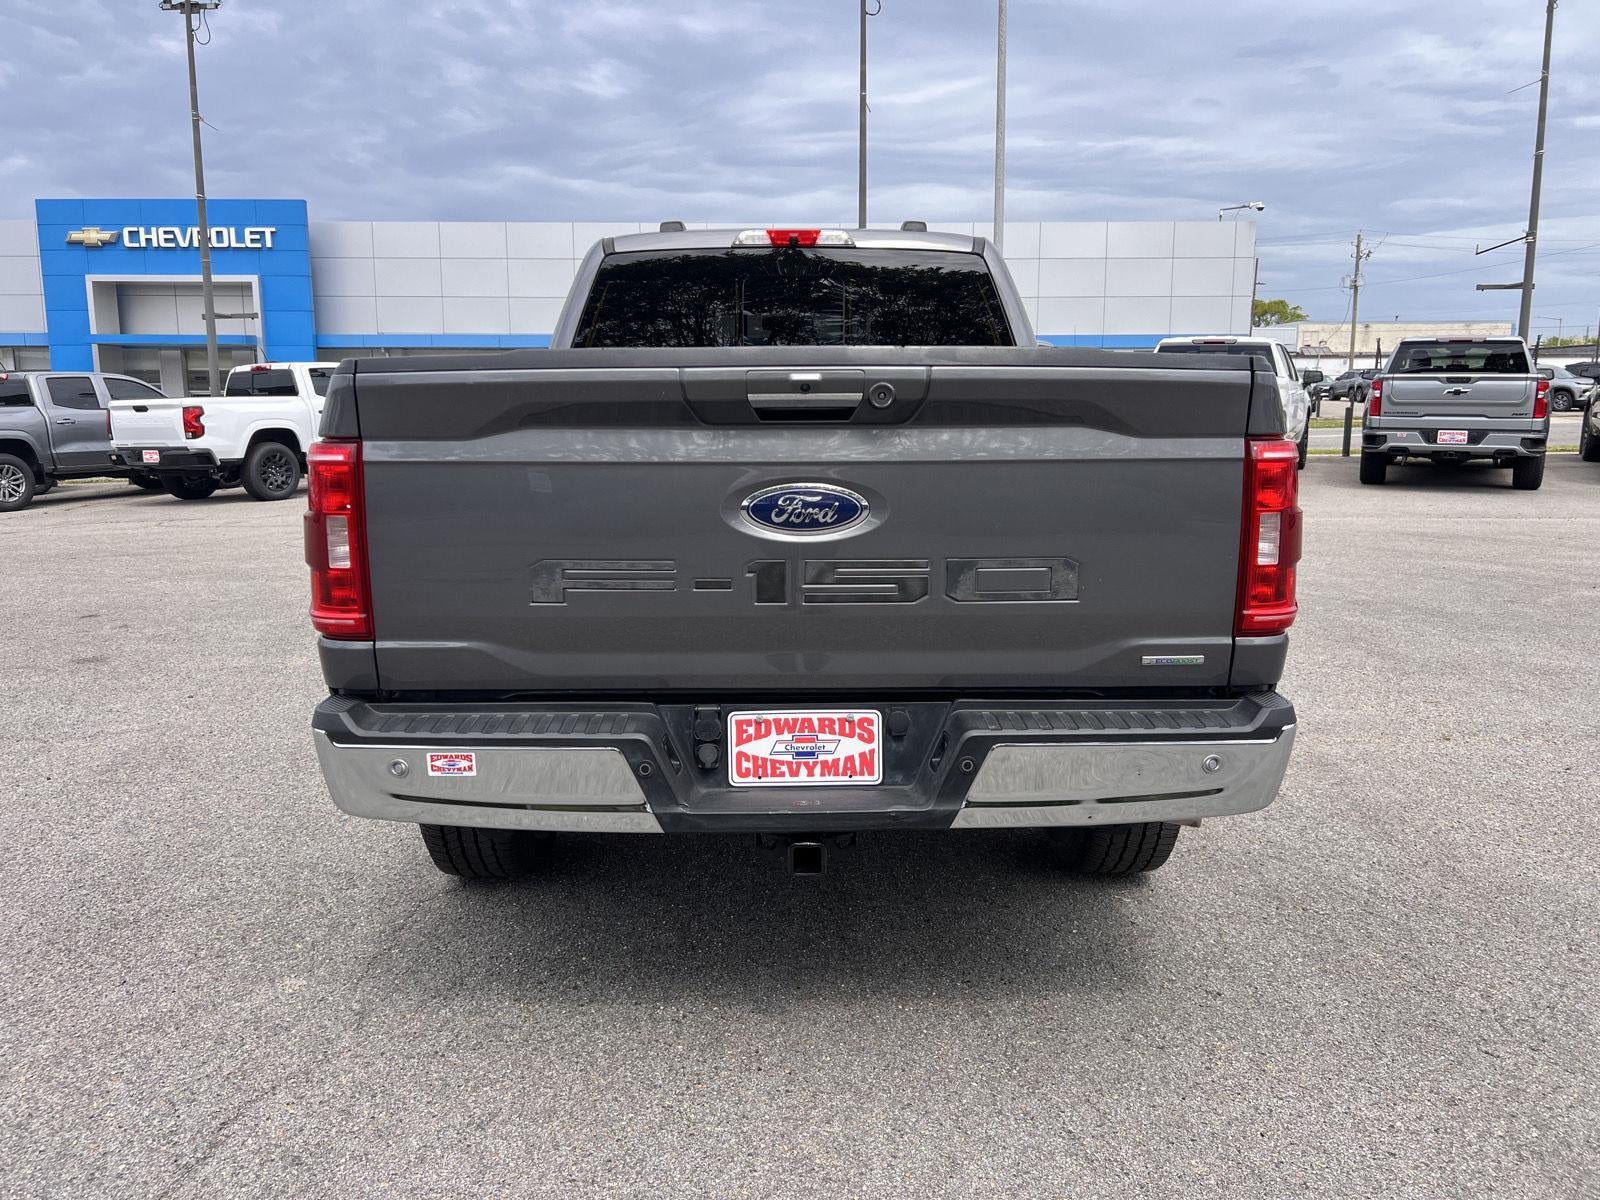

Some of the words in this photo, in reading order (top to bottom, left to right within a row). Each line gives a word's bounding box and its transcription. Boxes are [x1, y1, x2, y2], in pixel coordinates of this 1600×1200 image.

[122, 226, 276, 248] CHEVROLET
[770, 494, 839, 523] Ford
[529, 556, 1080, 606] F-150
[735, 716, 875, 748] EDWARDS
[430, 753, 473, 763] EDWARDS
[735, 748, 876, 778] CHEVYMAN
